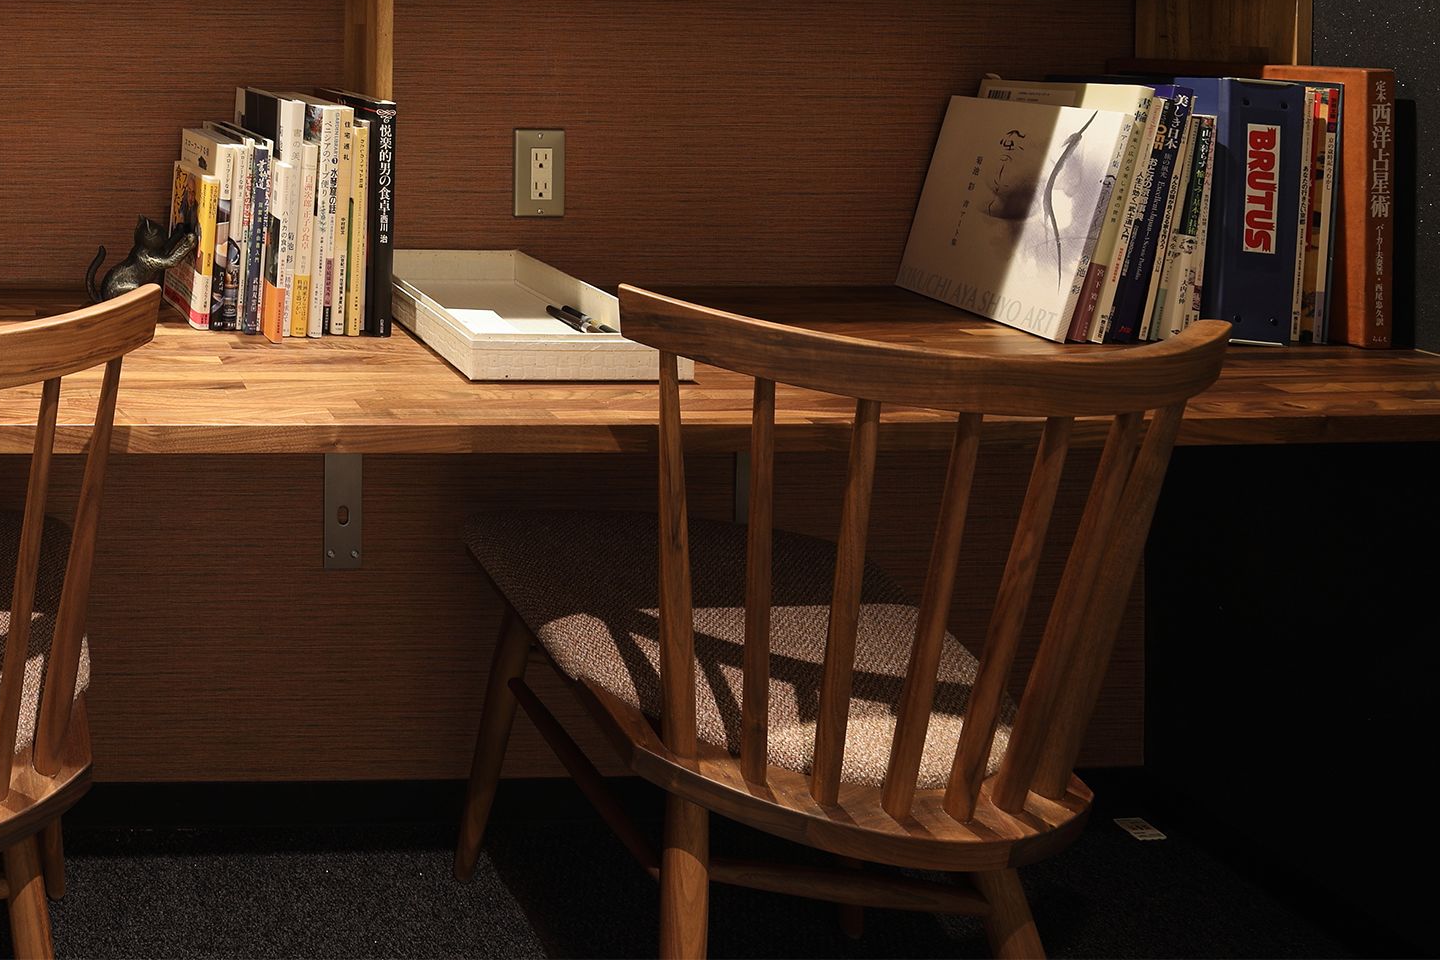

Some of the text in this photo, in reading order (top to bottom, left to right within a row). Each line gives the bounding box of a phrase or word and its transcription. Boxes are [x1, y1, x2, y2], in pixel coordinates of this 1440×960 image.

[1164, 93, 1190, 150] 美しき日本
[1370, 80, 1393, 218] 定本 西洋占星術
[377, 124, 393, 213] 悦楽的男の食卓
[1244, 127, 1277, 253] BRUTUS
[951, 281, 977, 311] AYA
[979, 291, 1023, 323] SHYO
[1023, 307, 1059, 336] ART
